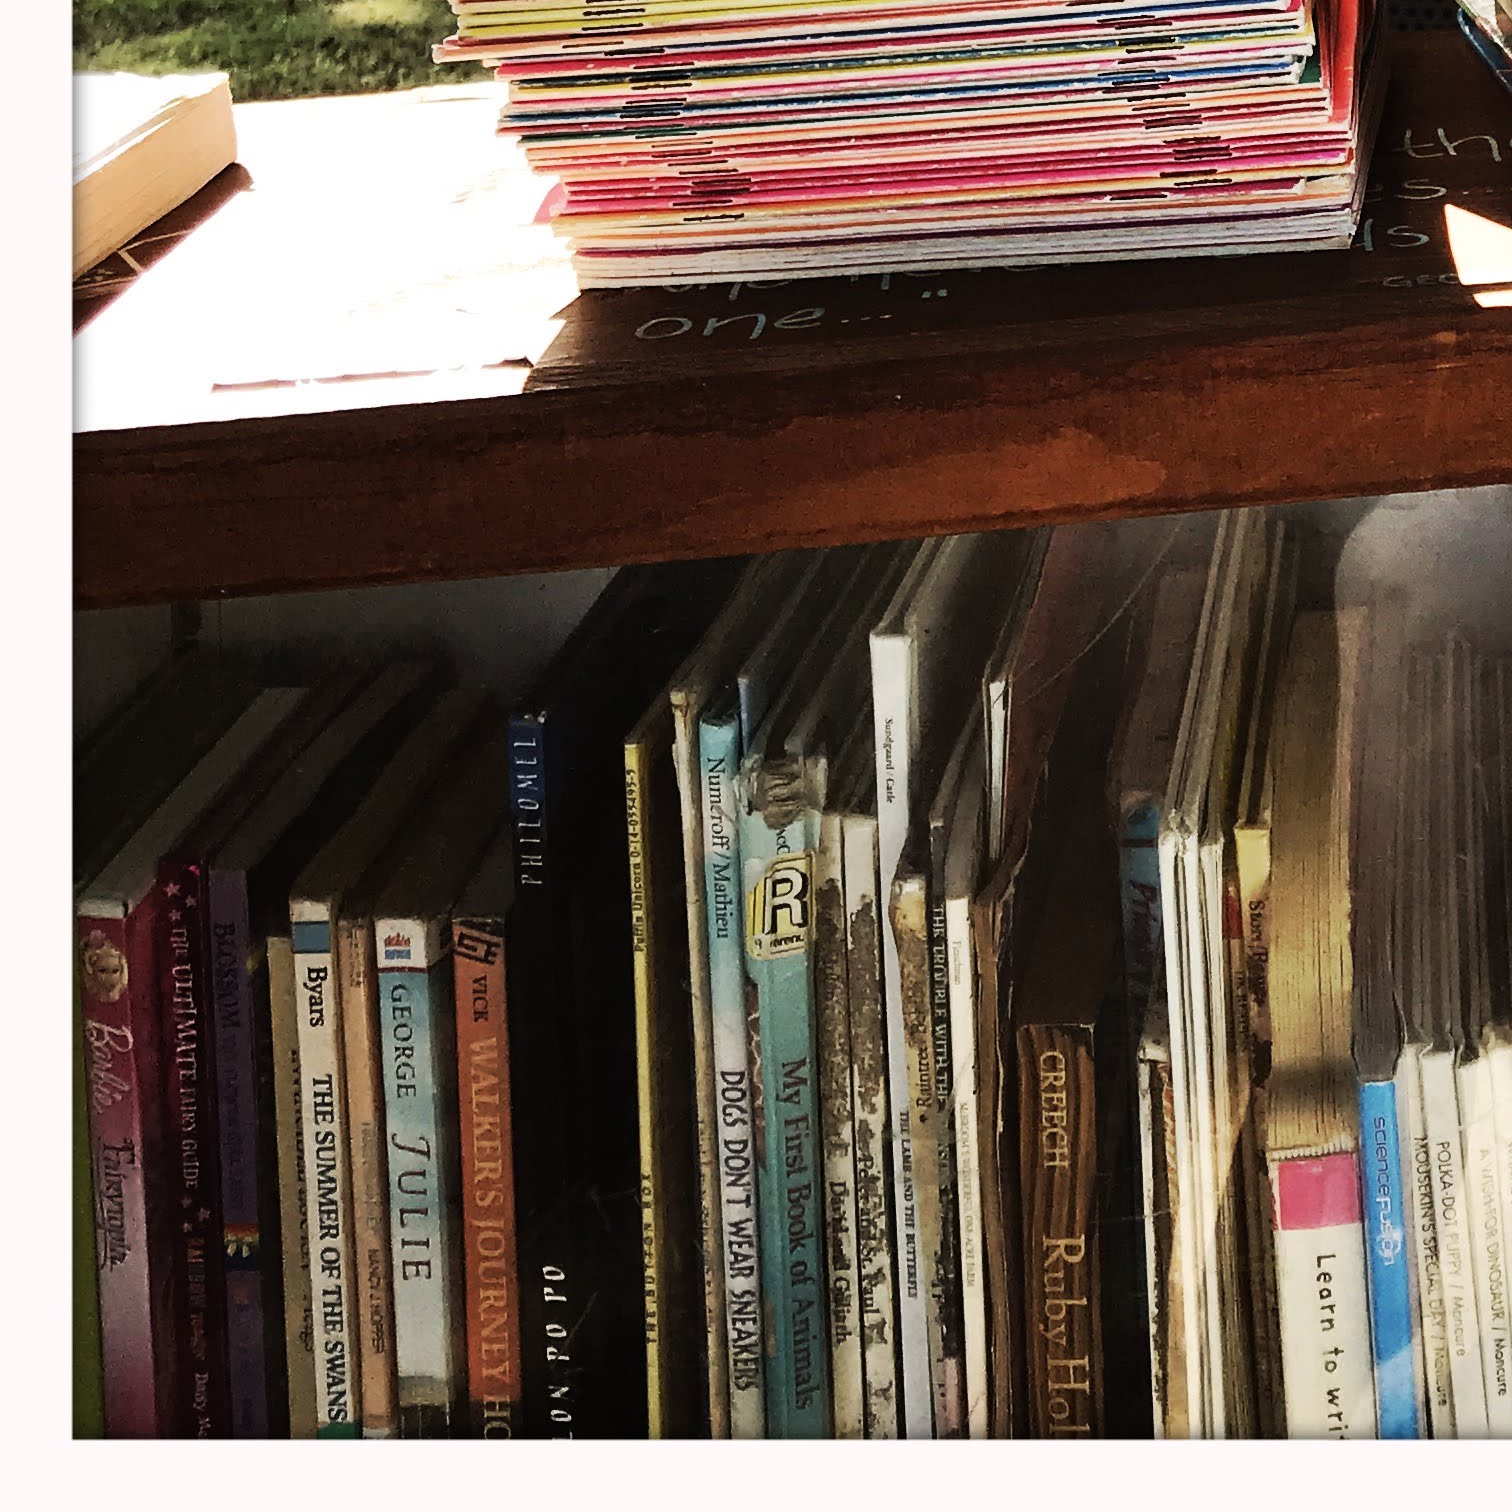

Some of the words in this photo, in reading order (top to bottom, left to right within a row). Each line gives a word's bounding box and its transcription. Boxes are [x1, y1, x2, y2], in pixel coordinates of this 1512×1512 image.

[513, 736, 544, 886] PHILOMEL
[705, 757, 732, 854] Numeroff
[630, 860, 645, 913] Unicorn
[712, 862, 731, 939] Mathieu
[169, 925, 191, 960] THE
[632, 917, 646, 953] Puffin
[930, 903, 947, 939] THE
[214, 921, 242, 1036] BLOSSOM
[306, 964, 329, 1029] Byars
[471, 973, 489, 1025] VICK
[932, 943, 948, 1019] TROUBLE
[171, 962, 201, 1082] ULTIMATE
[389, 983, 418, 1100] GEORGE
[934, 1022, 949, 1068] WITH
[86, 1017, 135, 1116] Barbie
[775, 1057, 808, 1107] My
[915, 1045, 934, 1109] Raintree
[936, 1070, 950, 1105] THE
[178, 1084, 198, 1132] FAIRY
[310, 1072, 335, 1128] THE
[720, 1069, 748, 1129] DOGS
[898, 1110, 911, 1135] THE
[1039, 1051, 1070, 1169] CREECH
[180, 1135, 202, 1192] GUIDE
[723, 1138, 752, 1208] DON'T
[784, 1112, 811, 1179] First
[900, 1137, 914, 1174] LAMB
[313, 1131, 342, 1243] SUMMER
[391, 1134, 433, 1283] JULIE
[902, 1175, 915, 1202] AND
[1435, 1140, 1458, 1228] POLKA-DOT
[787, 1183, 816, 1255] Book
[903, 1204, 917, 1231] THE
[318, 1246, 343, 1280] OF
[727, 1220, 758, 1280] WEAR
[789, 1260, 815, 1291] of
[904, 1232, 919, 1299] BUTTERFLY
[1423, 1233, 1441, 1302] SPECIAL
[1444, 1234, 1462, 1284] PUPPY
[320, 1284, 346, 1334] THE
[470, 1218, 509, 1394] JOURNEY
[541, 1263, 568, 1303] PO
[1039, 1233, 1088, 1348] Ruby
[1315, 1252, 1338, 1332] Learn
[1486, 1242, 1506, 1322] DINOSAUR
[544, 1321, 571, 1364] PO
[730, 1288, 763, 1392] SNEAKERS
[790, 1296, 821, 1412] Animals
[1450, 1295, 1467, 1357] Moncure
[324, 1340, 350, 1424] SWANS
[1323, 1346, 1346, 1374] to
[1493, 1337, 1509, 1397] Moncure
